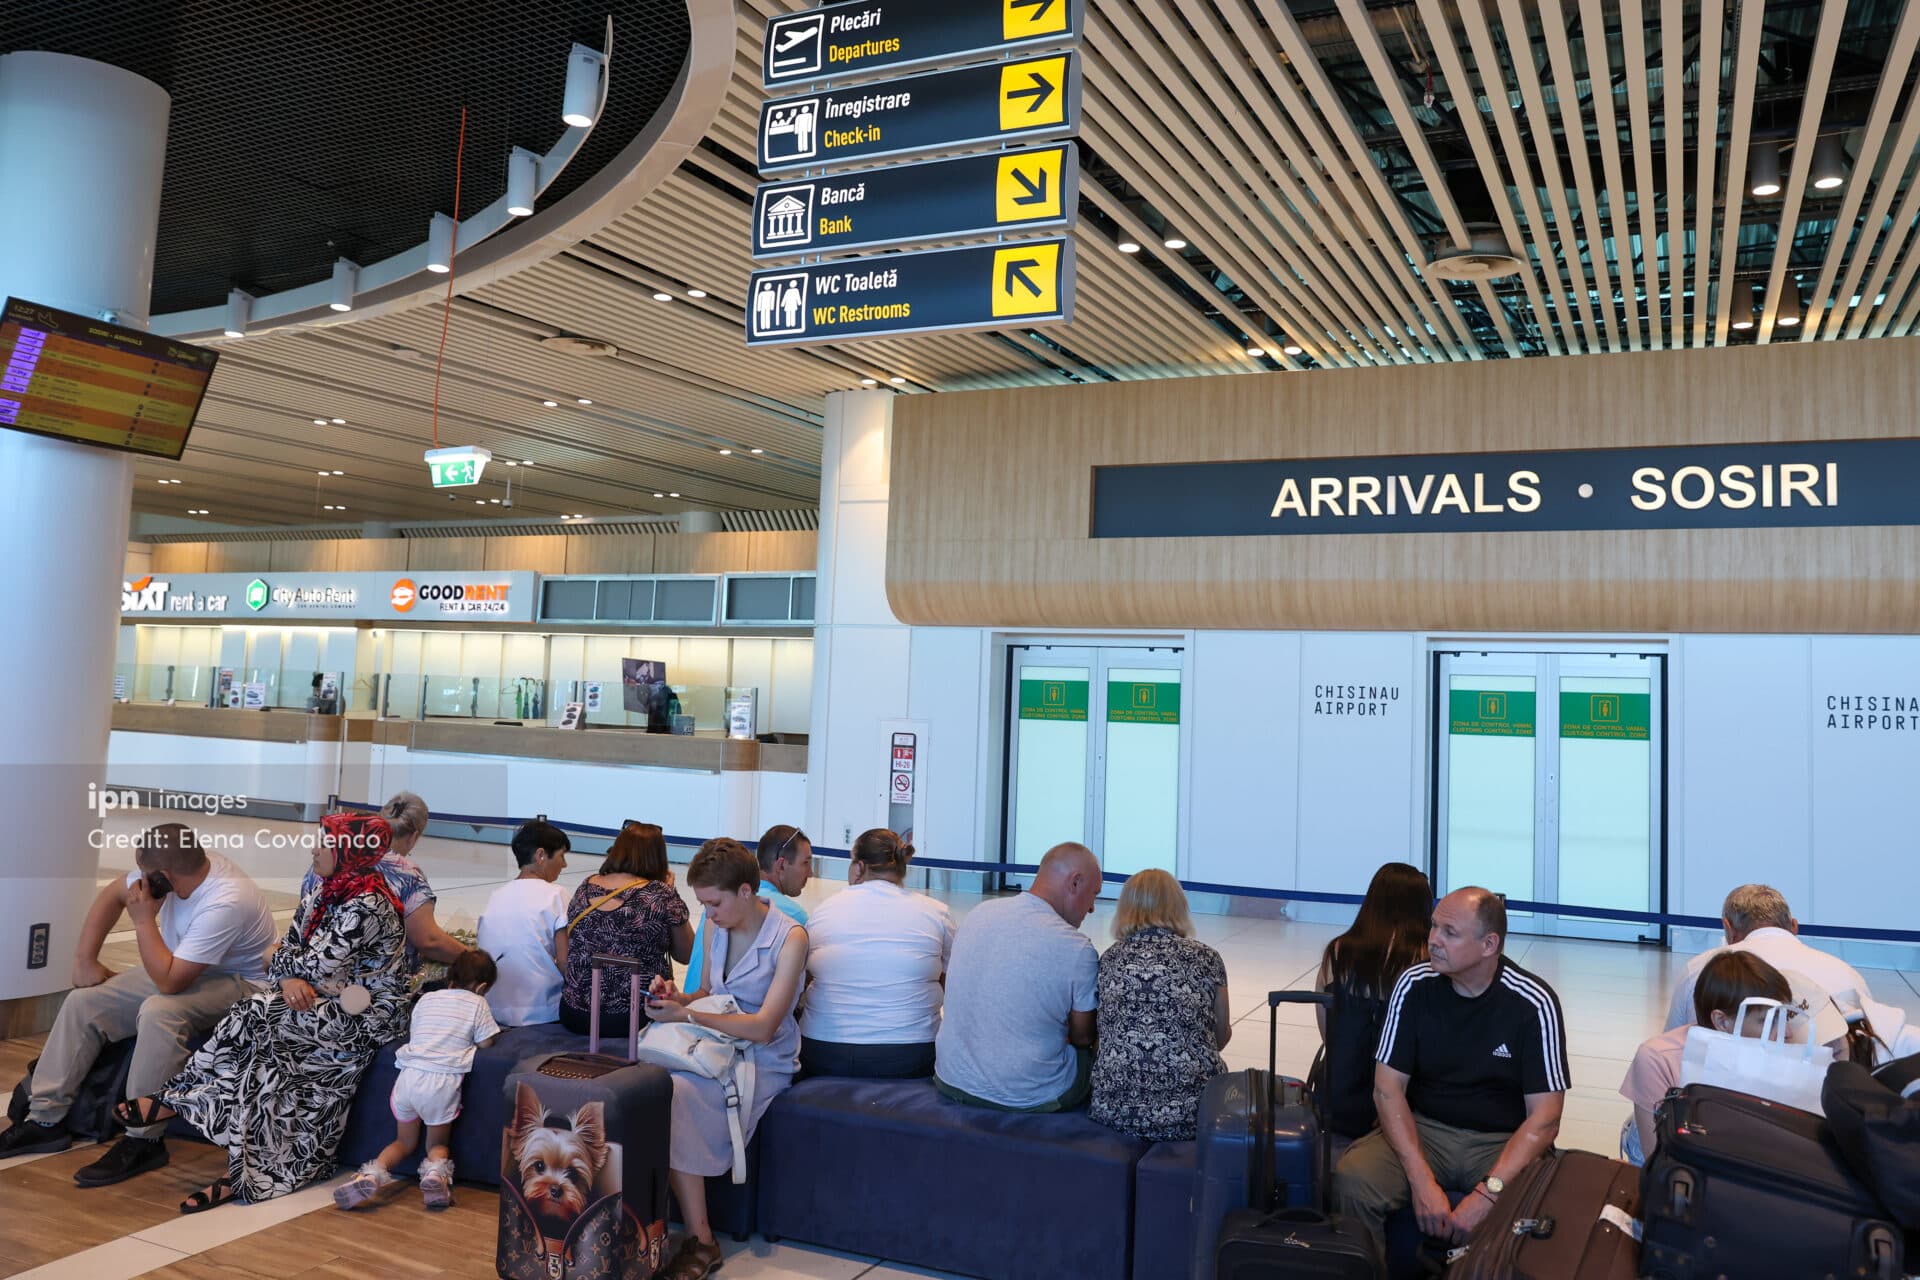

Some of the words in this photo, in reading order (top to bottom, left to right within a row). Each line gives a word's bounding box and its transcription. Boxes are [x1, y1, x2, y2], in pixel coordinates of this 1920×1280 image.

[830, 8, 882, 34] Plecări
[829, 38, 900, 64] Departures
[825, 92, 911, 119] Înregistrare
[824, 124, 881, 148] Check-in
[820, 183, 865, 206] Bancă
[819, 215, 852, 235] Bank
[815, 275, 841, 295] WC
[845, 269, 898, 292] Toaletă
[813, 306, 836, 326] WC
[839, 303, 911, 323] Restrooms
[1270, 471, 1542, 518] ARRIVALS
[1630, 462, 1838, 511] SOSIRI
[170, 592, 195, 611] rent
[197, 596, 204, 611] a
[207, 595, 228, 611] car
[440, 602, 459, 612] RENT
[468, 602, 482, 612] CAR
[483, 602, 506, 612] 24/24
[1314, 684, 1400, 701] CHISINAU
[1826, 695, 1920, 712] CHISINA
[1314, 700, 1389, 717] AIRPORT
[1826, 713, 1920, 731] AIRPORT
